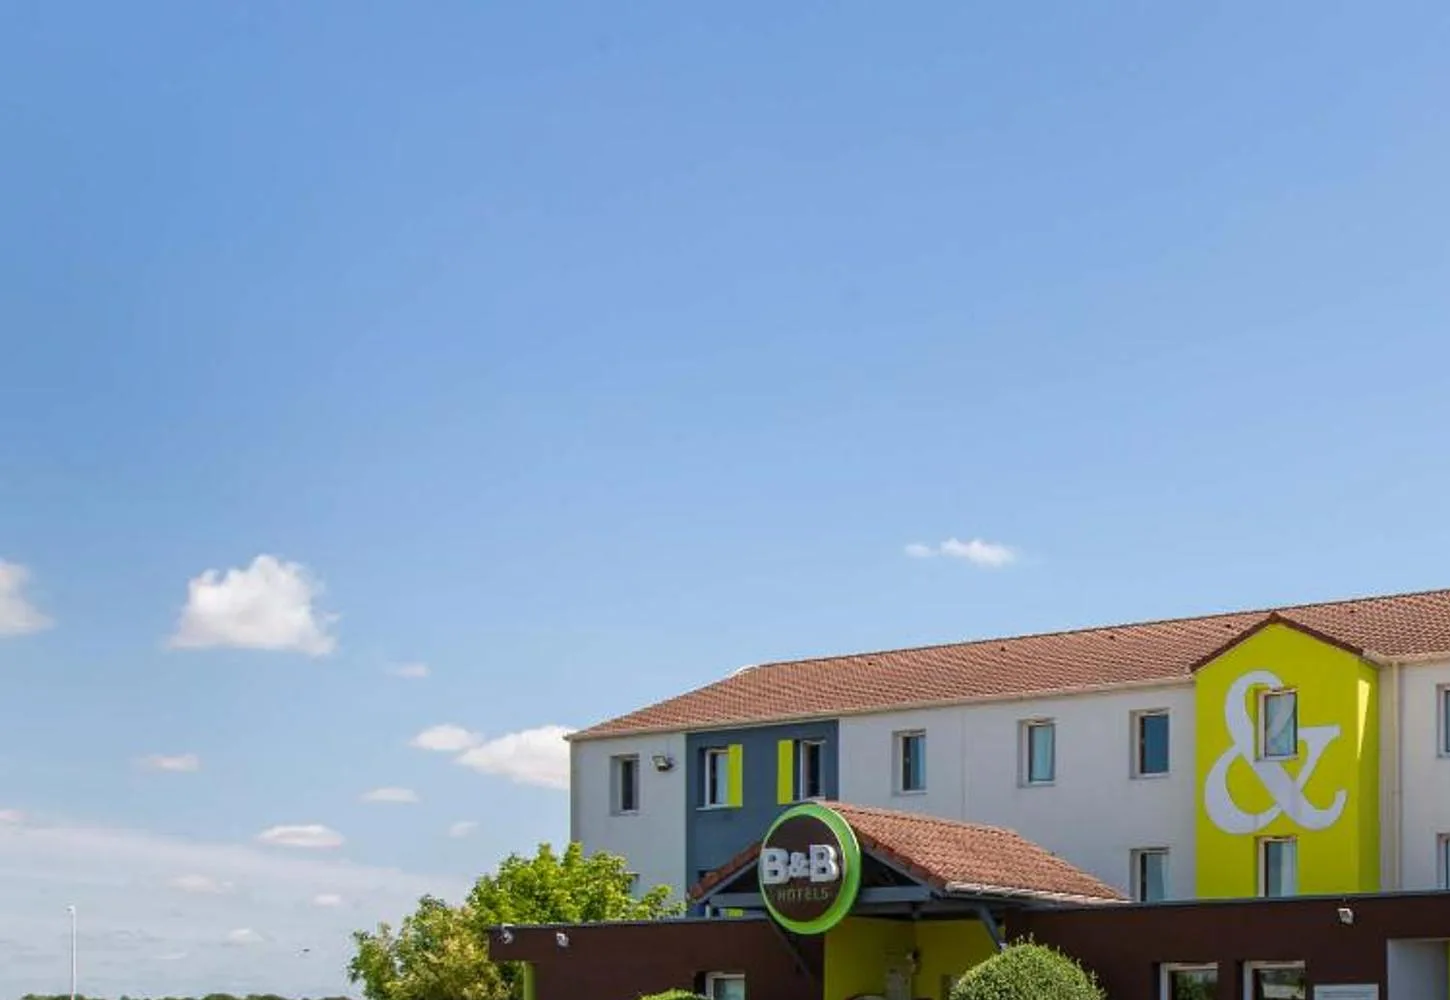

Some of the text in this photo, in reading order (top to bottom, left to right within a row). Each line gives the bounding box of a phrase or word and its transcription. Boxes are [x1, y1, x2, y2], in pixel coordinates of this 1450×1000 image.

[1204, 670, 1347, 834] &
[762, 844, 840, 884] B&B
[777, 886, 829, 902] HOTELS
